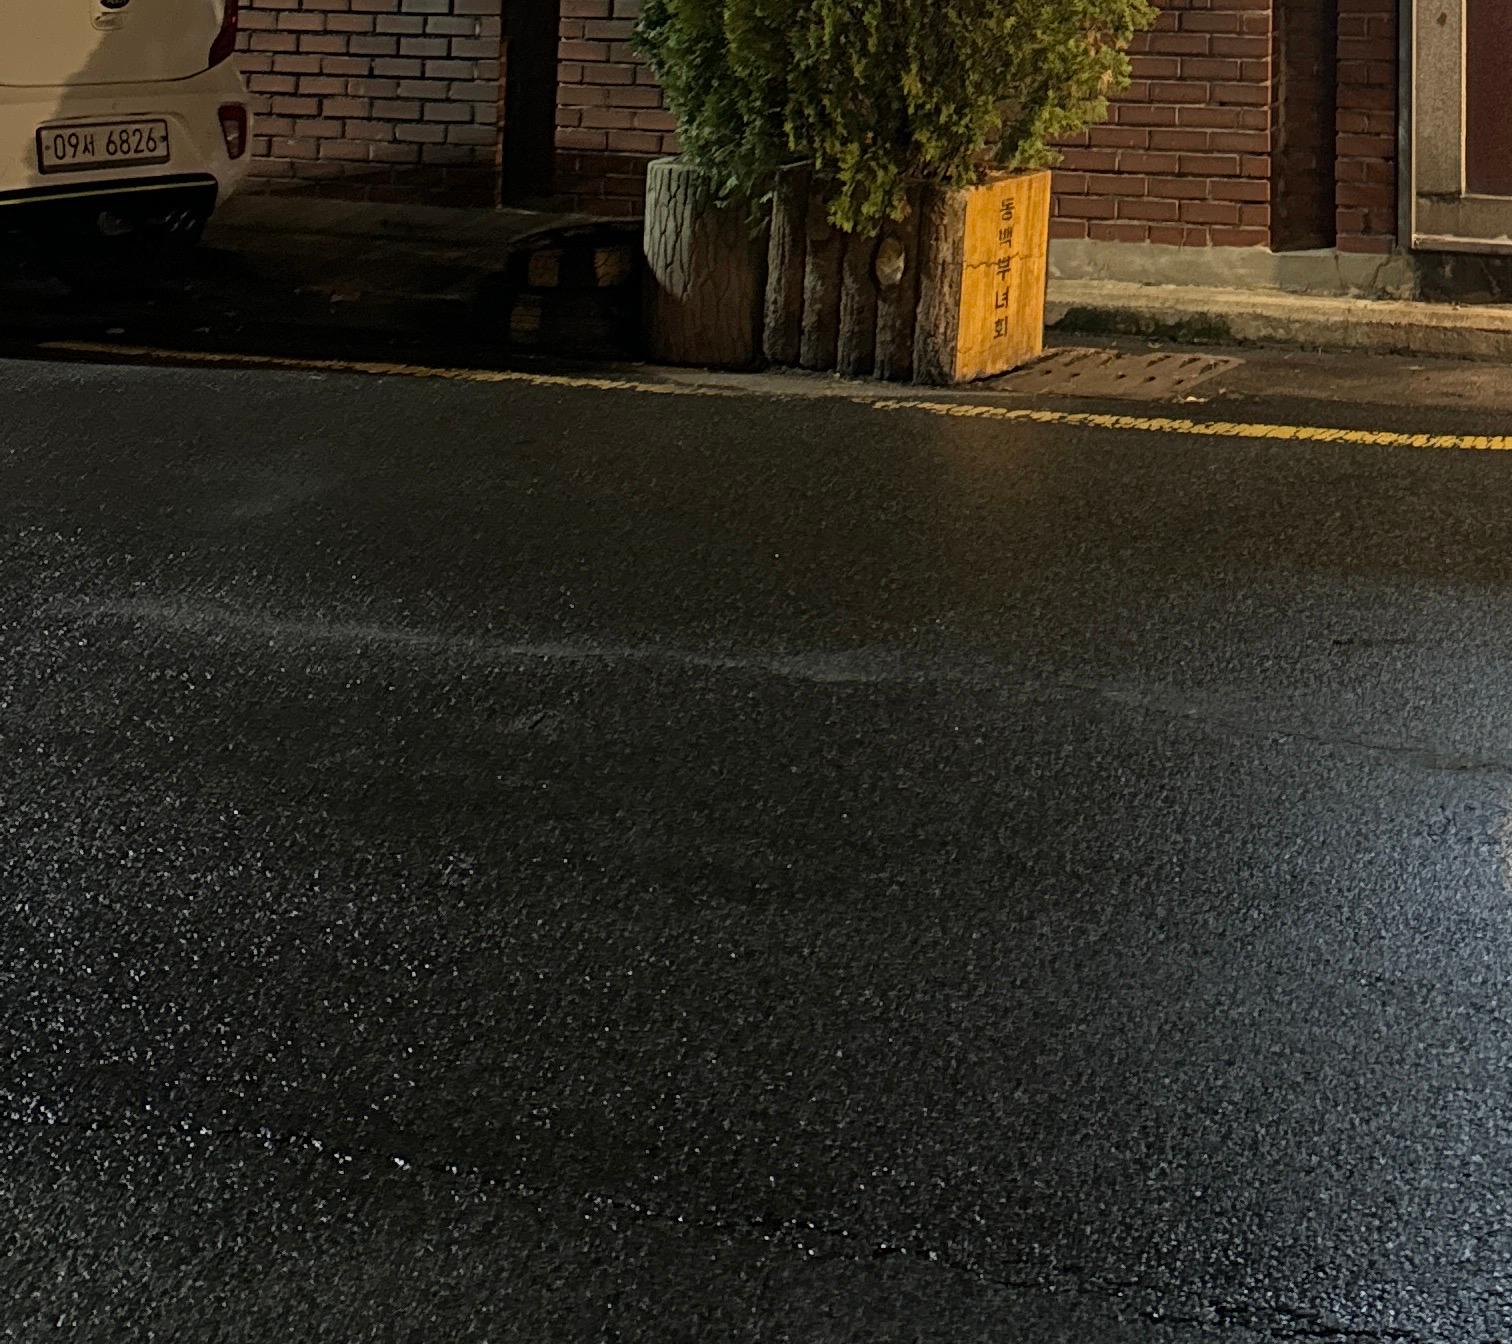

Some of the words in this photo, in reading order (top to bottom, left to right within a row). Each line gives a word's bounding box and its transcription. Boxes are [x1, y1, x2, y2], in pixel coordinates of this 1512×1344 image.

[54, 133, 95, 160] 09서
[106, 128, 157, 155] 6826
[994, 197, 1015, 339] 동백부녀회
